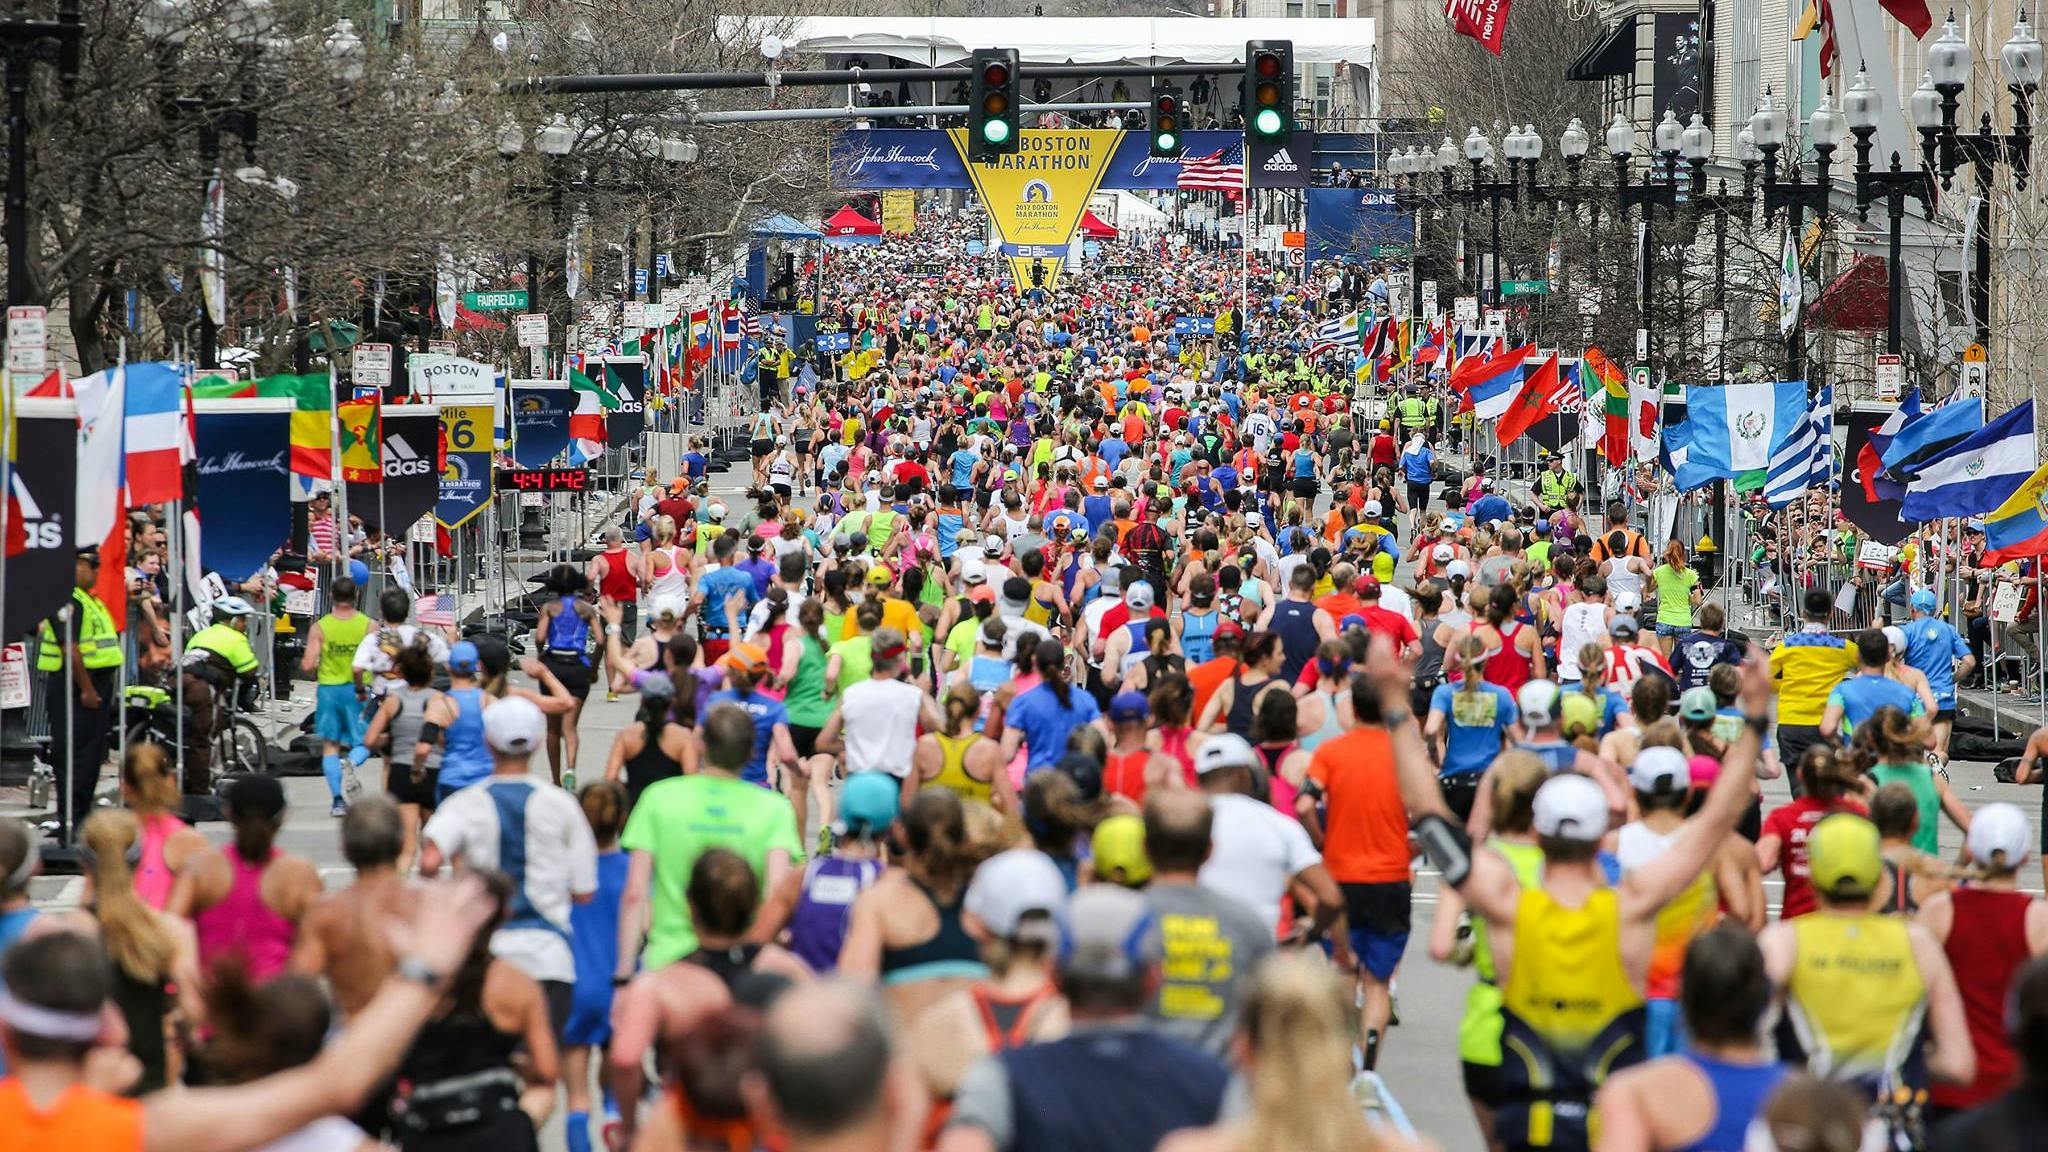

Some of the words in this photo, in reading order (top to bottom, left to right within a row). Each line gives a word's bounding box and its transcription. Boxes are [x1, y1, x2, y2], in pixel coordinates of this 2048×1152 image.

[1482, 14, 1496, 40] new
[1020, 136, 1090, 152] BOSTON
[1263, 160, 1298, 172] adidas
[1514, 283, 1529, 293] RING
[477, 294, 516, 307] FAIRFIELD
[1190, 318, 1200, 333] 3
[827, 335, 836, 349] 3
[423, 364, 480, 379] BOSTON
[440, 407, 467, 419] Mile
[1252, 422, 1265, 437] 16
[382, 458, 431, 478] idas
